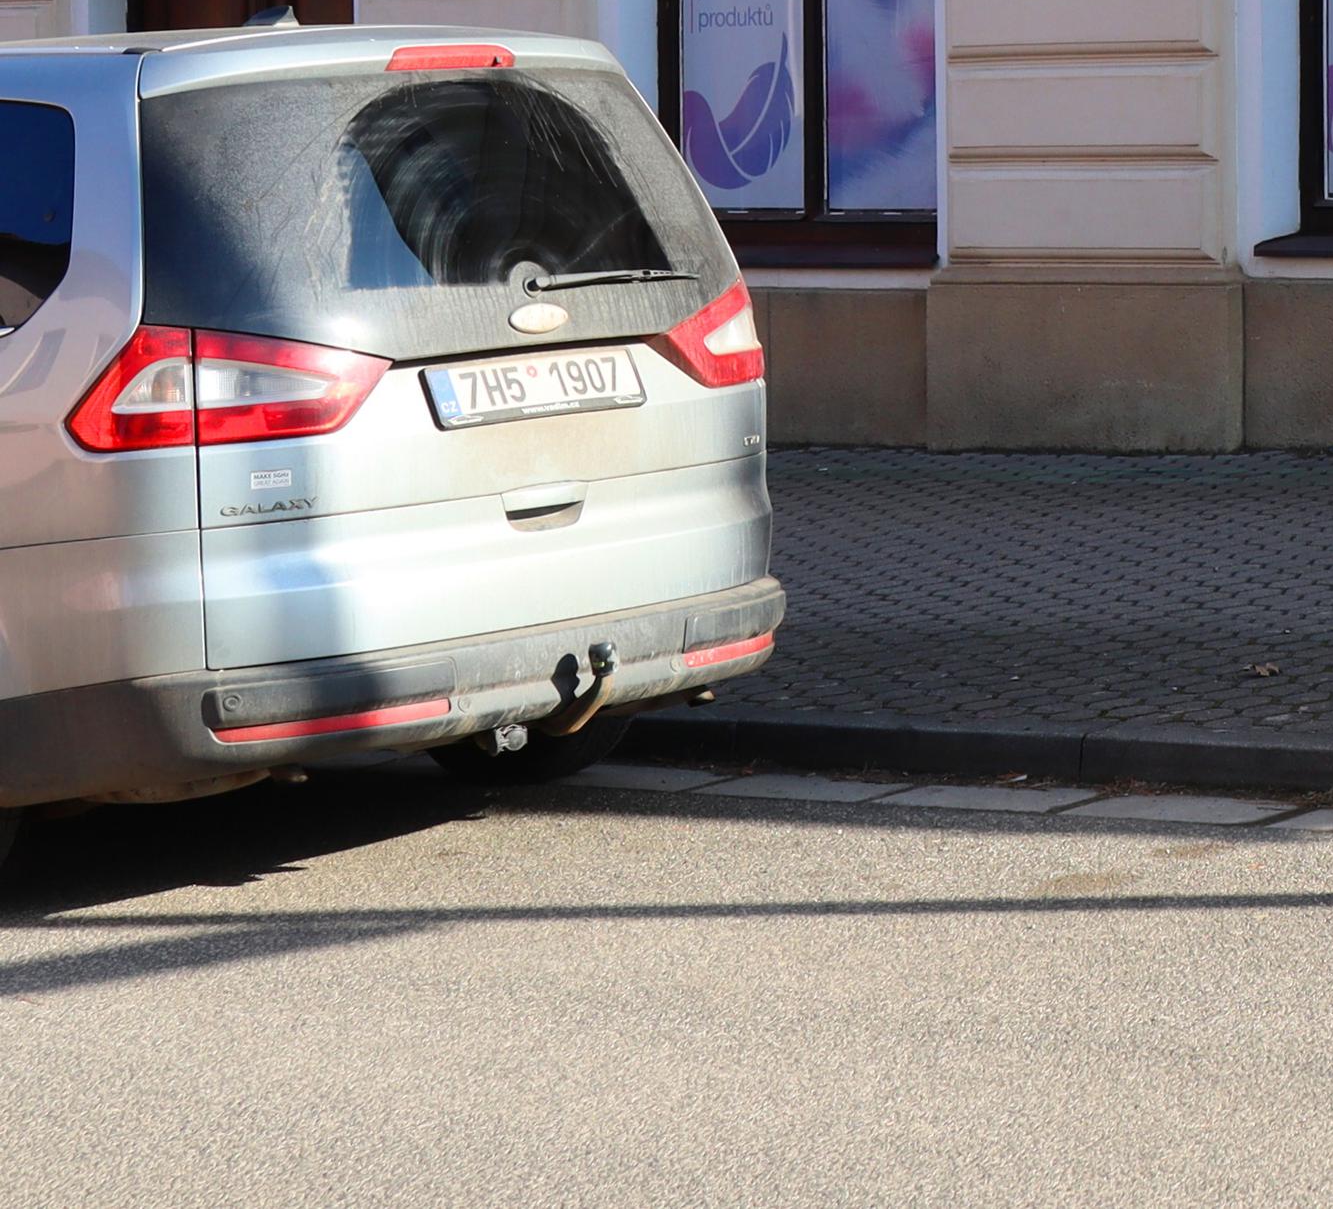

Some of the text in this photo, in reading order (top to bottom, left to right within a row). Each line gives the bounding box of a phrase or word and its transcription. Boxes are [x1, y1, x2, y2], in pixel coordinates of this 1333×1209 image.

[698, 4, 774, 31] produktů
[458, 355, 617, 410] 7H5 1907
[441, 402, 459, 414] CZ
[220, 496, 319, 516] GALAXY
